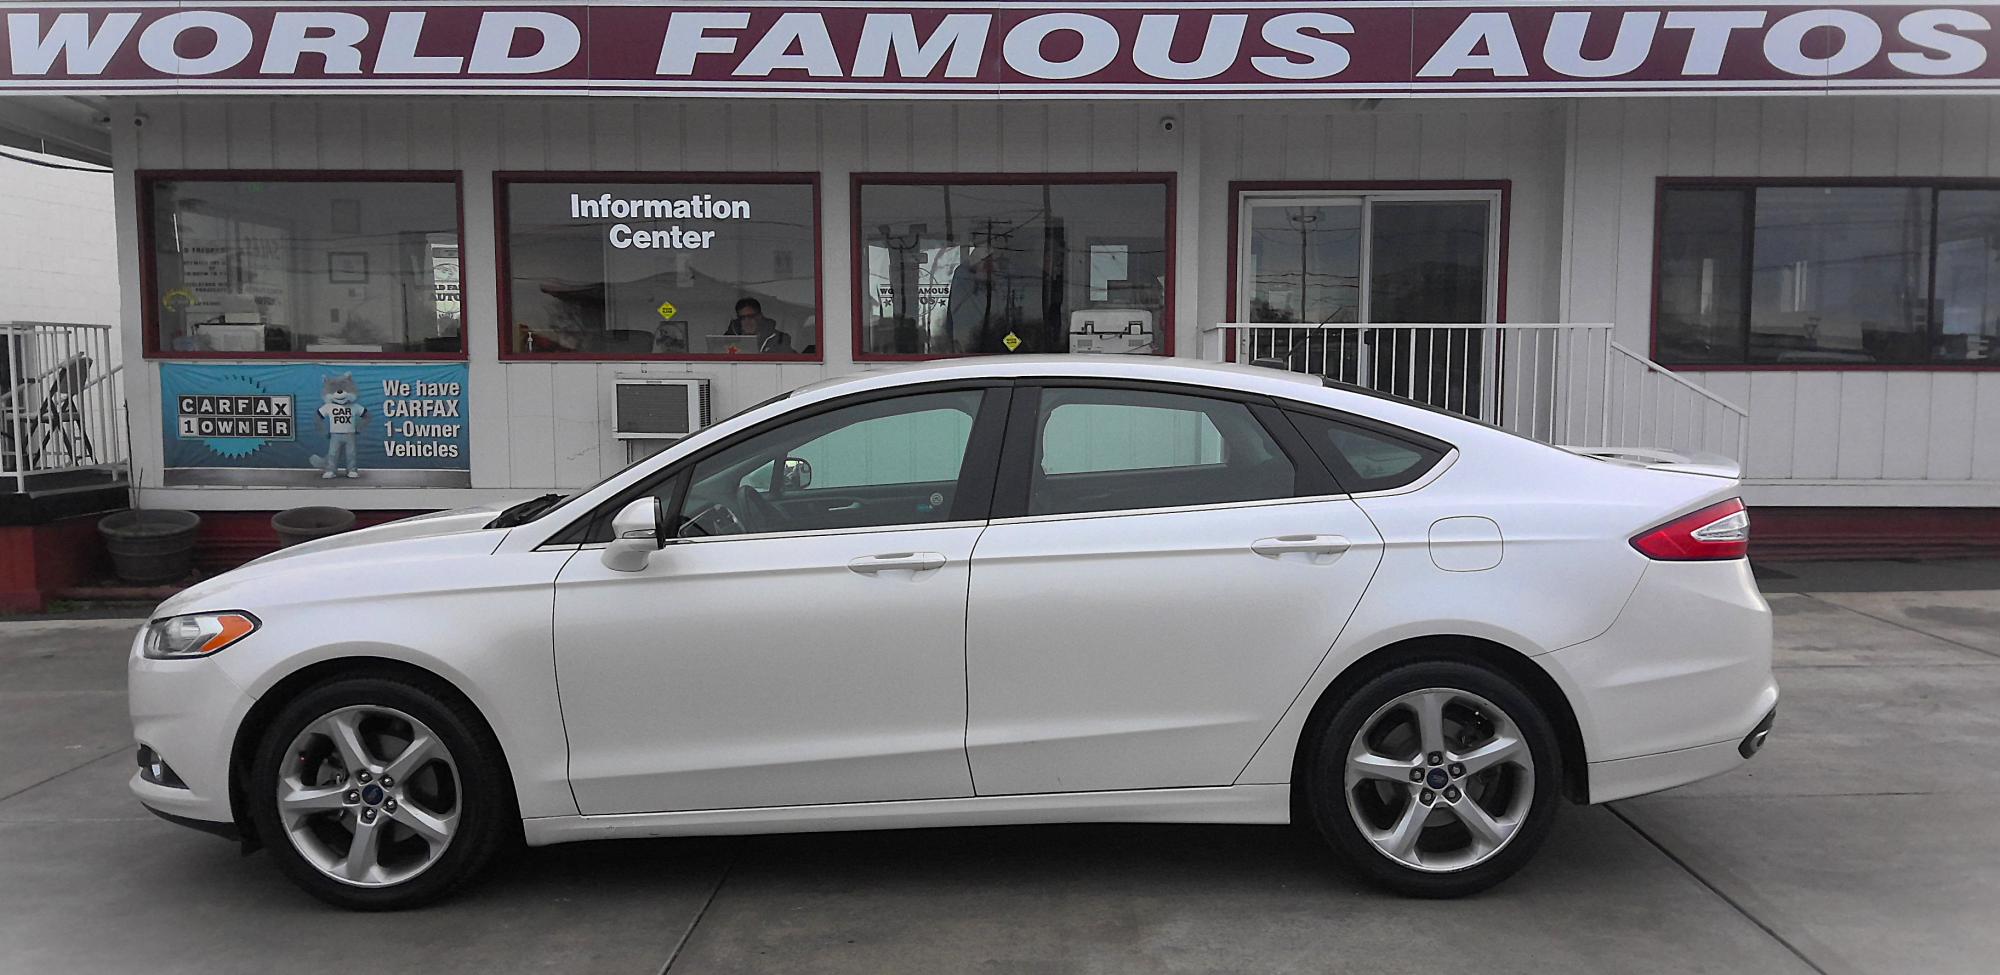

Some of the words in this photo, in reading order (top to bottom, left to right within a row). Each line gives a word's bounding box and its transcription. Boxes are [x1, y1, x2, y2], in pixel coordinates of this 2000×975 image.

[7, 10, 580, 75] WORLD
[656, 11, 1354, 78] FAMOUS
[1417, 9, 1991, 77] AUTOS
[570, 193, 750, 219] Information
[609, 224, 715, 249] Center
[383, 379, 410, 396] We
[416, 379, 460, 396] have
[181, 399, 287, 416] CARFAX
[332, 407, 352, 416] CAR
[383, 399, 459, 417] CARFAX
[333, 416, 352, 425] FOX
[384, 420, 460, 438] 1-Owner
[384, 440, 459, 458] Vehicles
